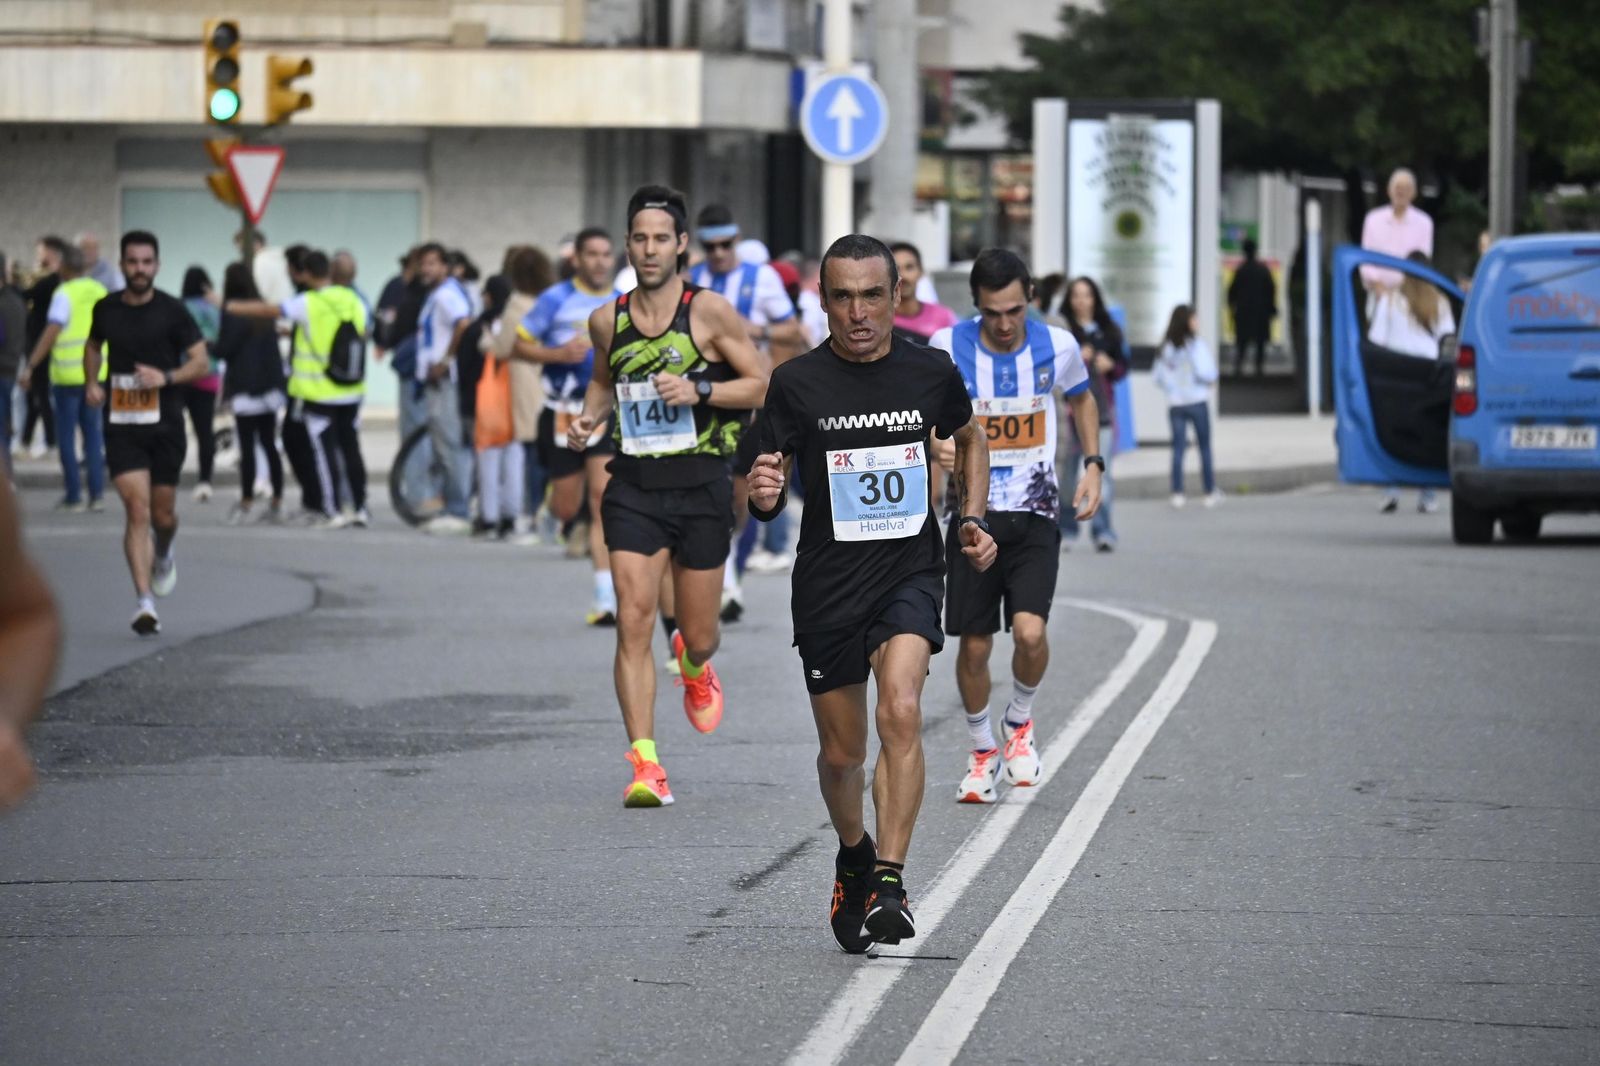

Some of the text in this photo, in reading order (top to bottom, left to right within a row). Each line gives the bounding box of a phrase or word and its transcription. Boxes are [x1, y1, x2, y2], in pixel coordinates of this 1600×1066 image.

[629, 401, 680, 427] 140
[887, 424, 923, 432] ZIGTECH
[986, 413, 1035, 441] 501
[858, 470, 905, 505] 30
[858, 512, 886, 520] GONZALEZ
[860, 520, 904, 533] Huelva
